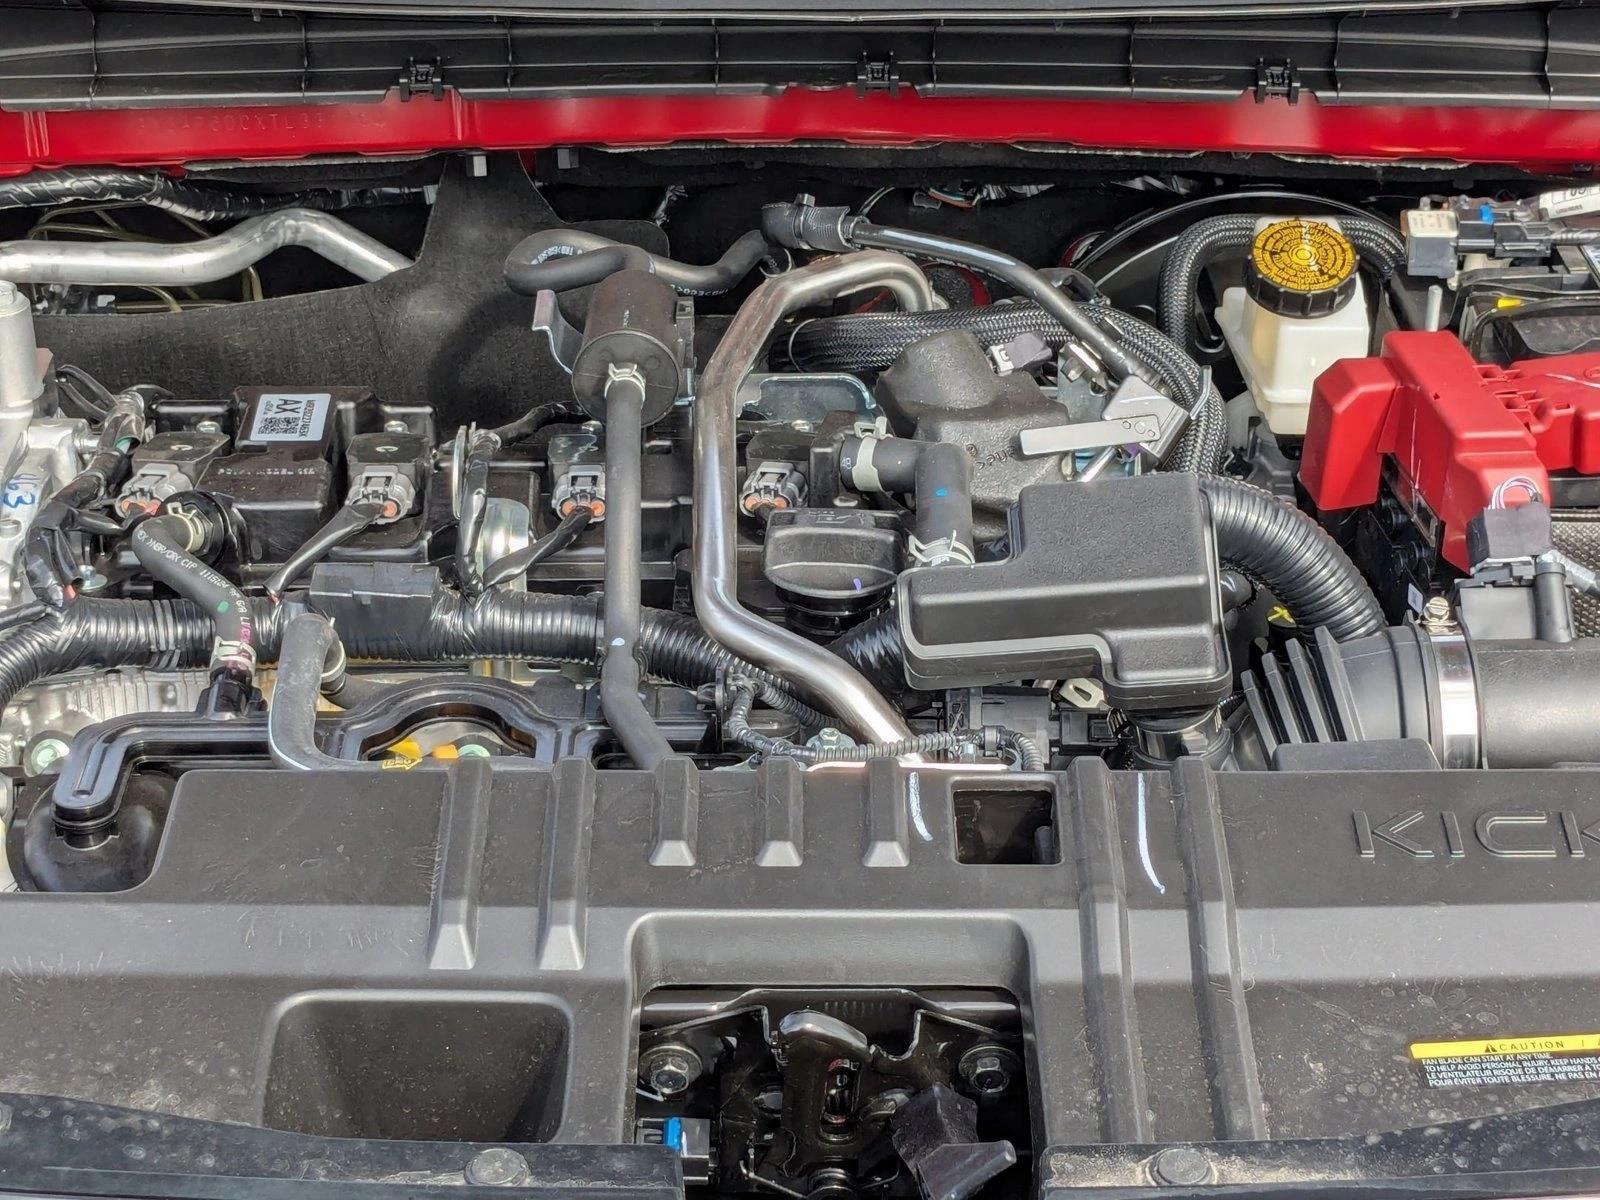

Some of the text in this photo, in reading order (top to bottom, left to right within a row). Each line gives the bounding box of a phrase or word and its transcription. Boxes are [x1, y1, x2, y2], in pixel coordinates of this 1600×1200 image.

[274, 398, 303, 414] AX
[1500, 1040, 1564, 1052] CAUTION
[1422, 1058, 1438, 1066] FAN
[1464, 1056, 1480, 1064] CAN
[1481, 1054, 1504, 1062] START
[1437, 1064, 1457, 1072] HELP
[1482, 1061, 1522, 1070] PERSONAL
[1550, 1058, 1569, 1066] KEEP
[1570, 1056, 1597, 1064] HANDS
[1426, 1072, 1437, 1080] LE
[1438, 1070, 1492, 1079] VENTILATEUR
[1493, 1068, 1524, 1076] RISQUE
[1525, 1066, 1538, 1074] DE
[1428, 1079, 1454, 1087] POUR
[1483, 1076, 1510, 1084] TOUTE
[1555, 1072, 1567, 1080] NE
